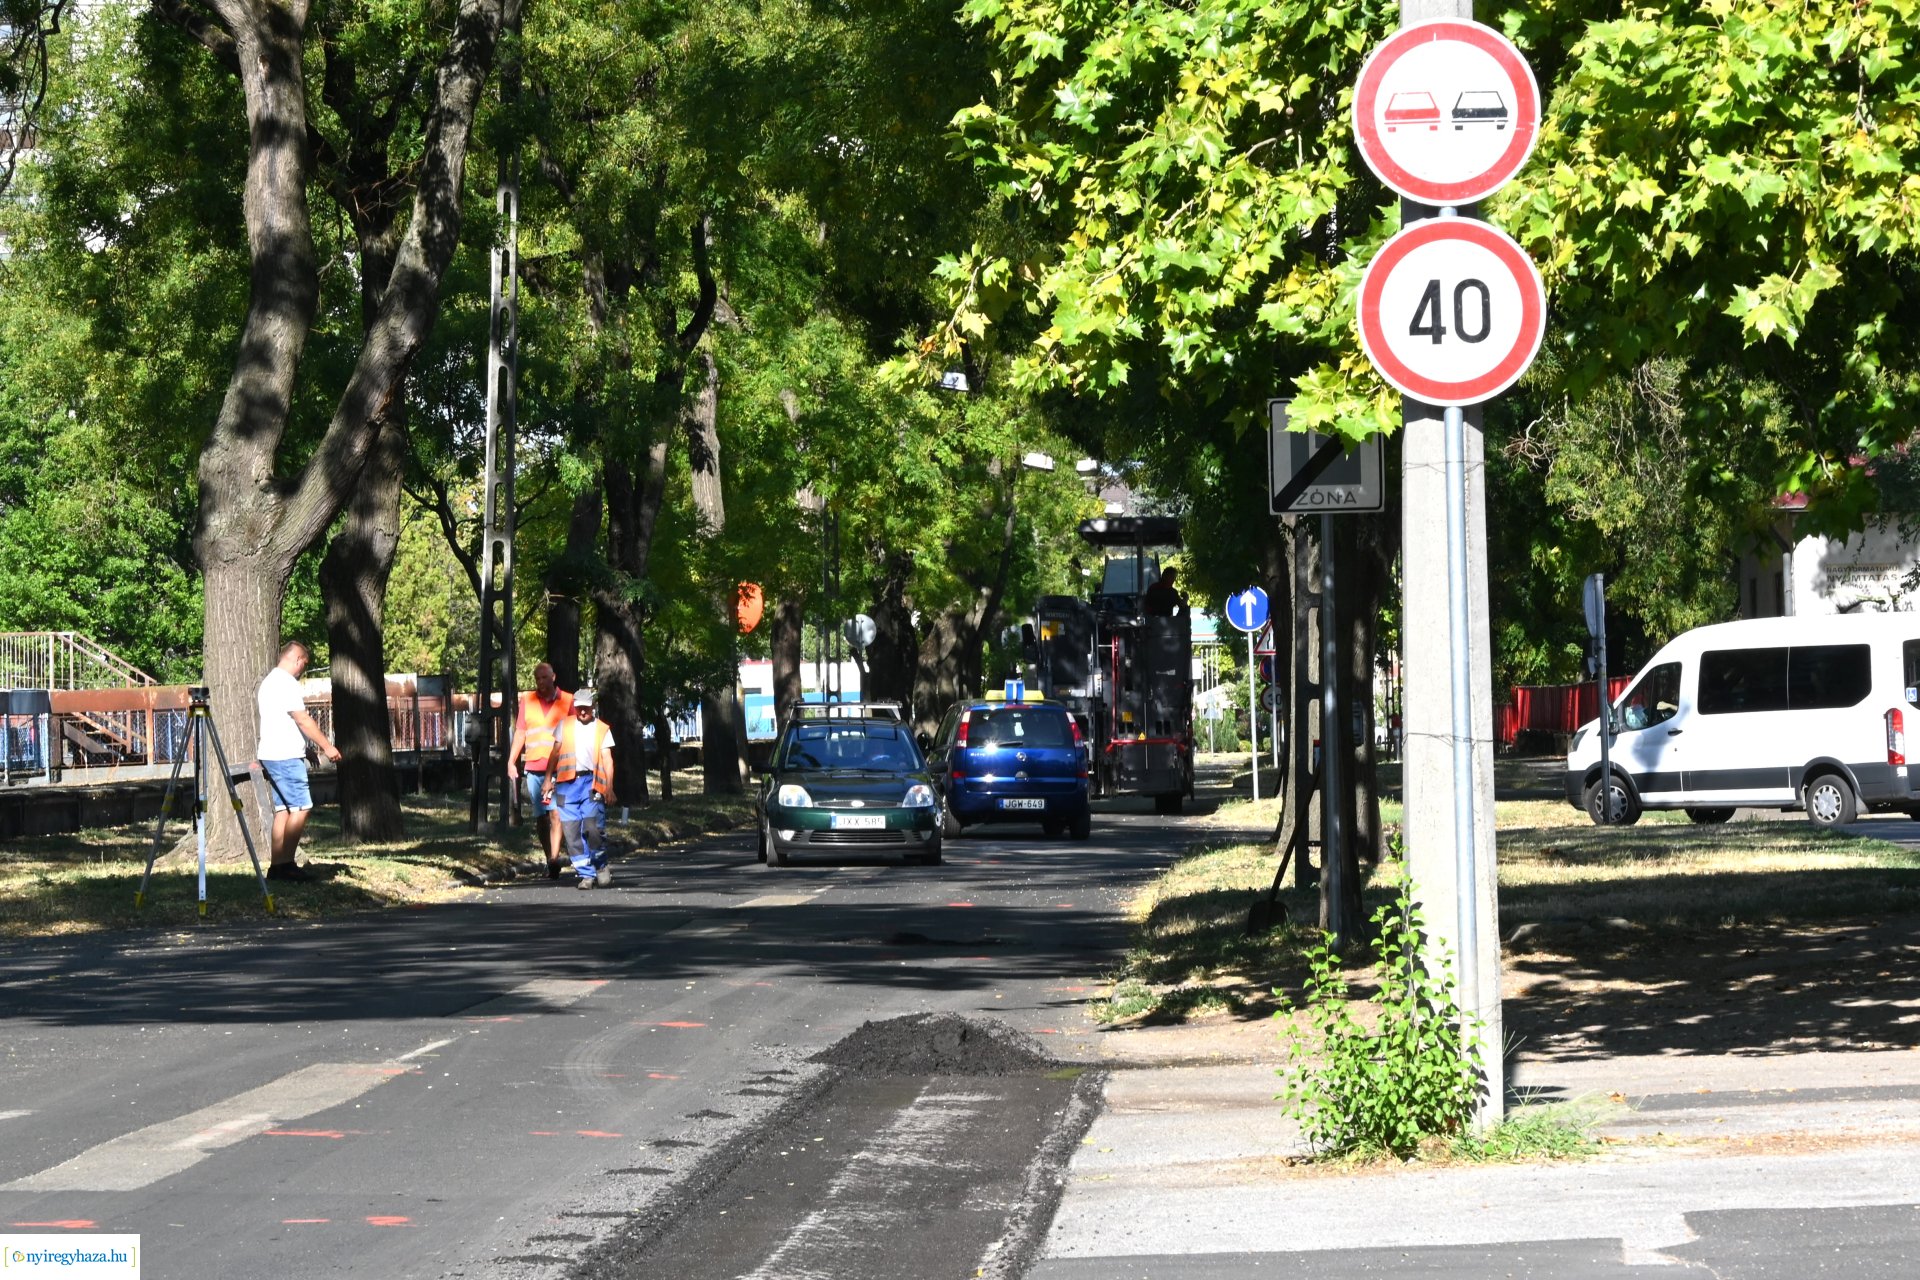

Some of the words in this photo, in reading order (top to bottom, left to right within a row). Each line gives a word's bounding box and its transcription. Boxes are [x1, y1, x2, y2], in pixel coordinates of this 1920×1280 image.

[1409, 278, 1491, 344] 40
[1295, 488, 1357, 506] ZÓNA
[1005, 799, 1043, 808] JGW-649
